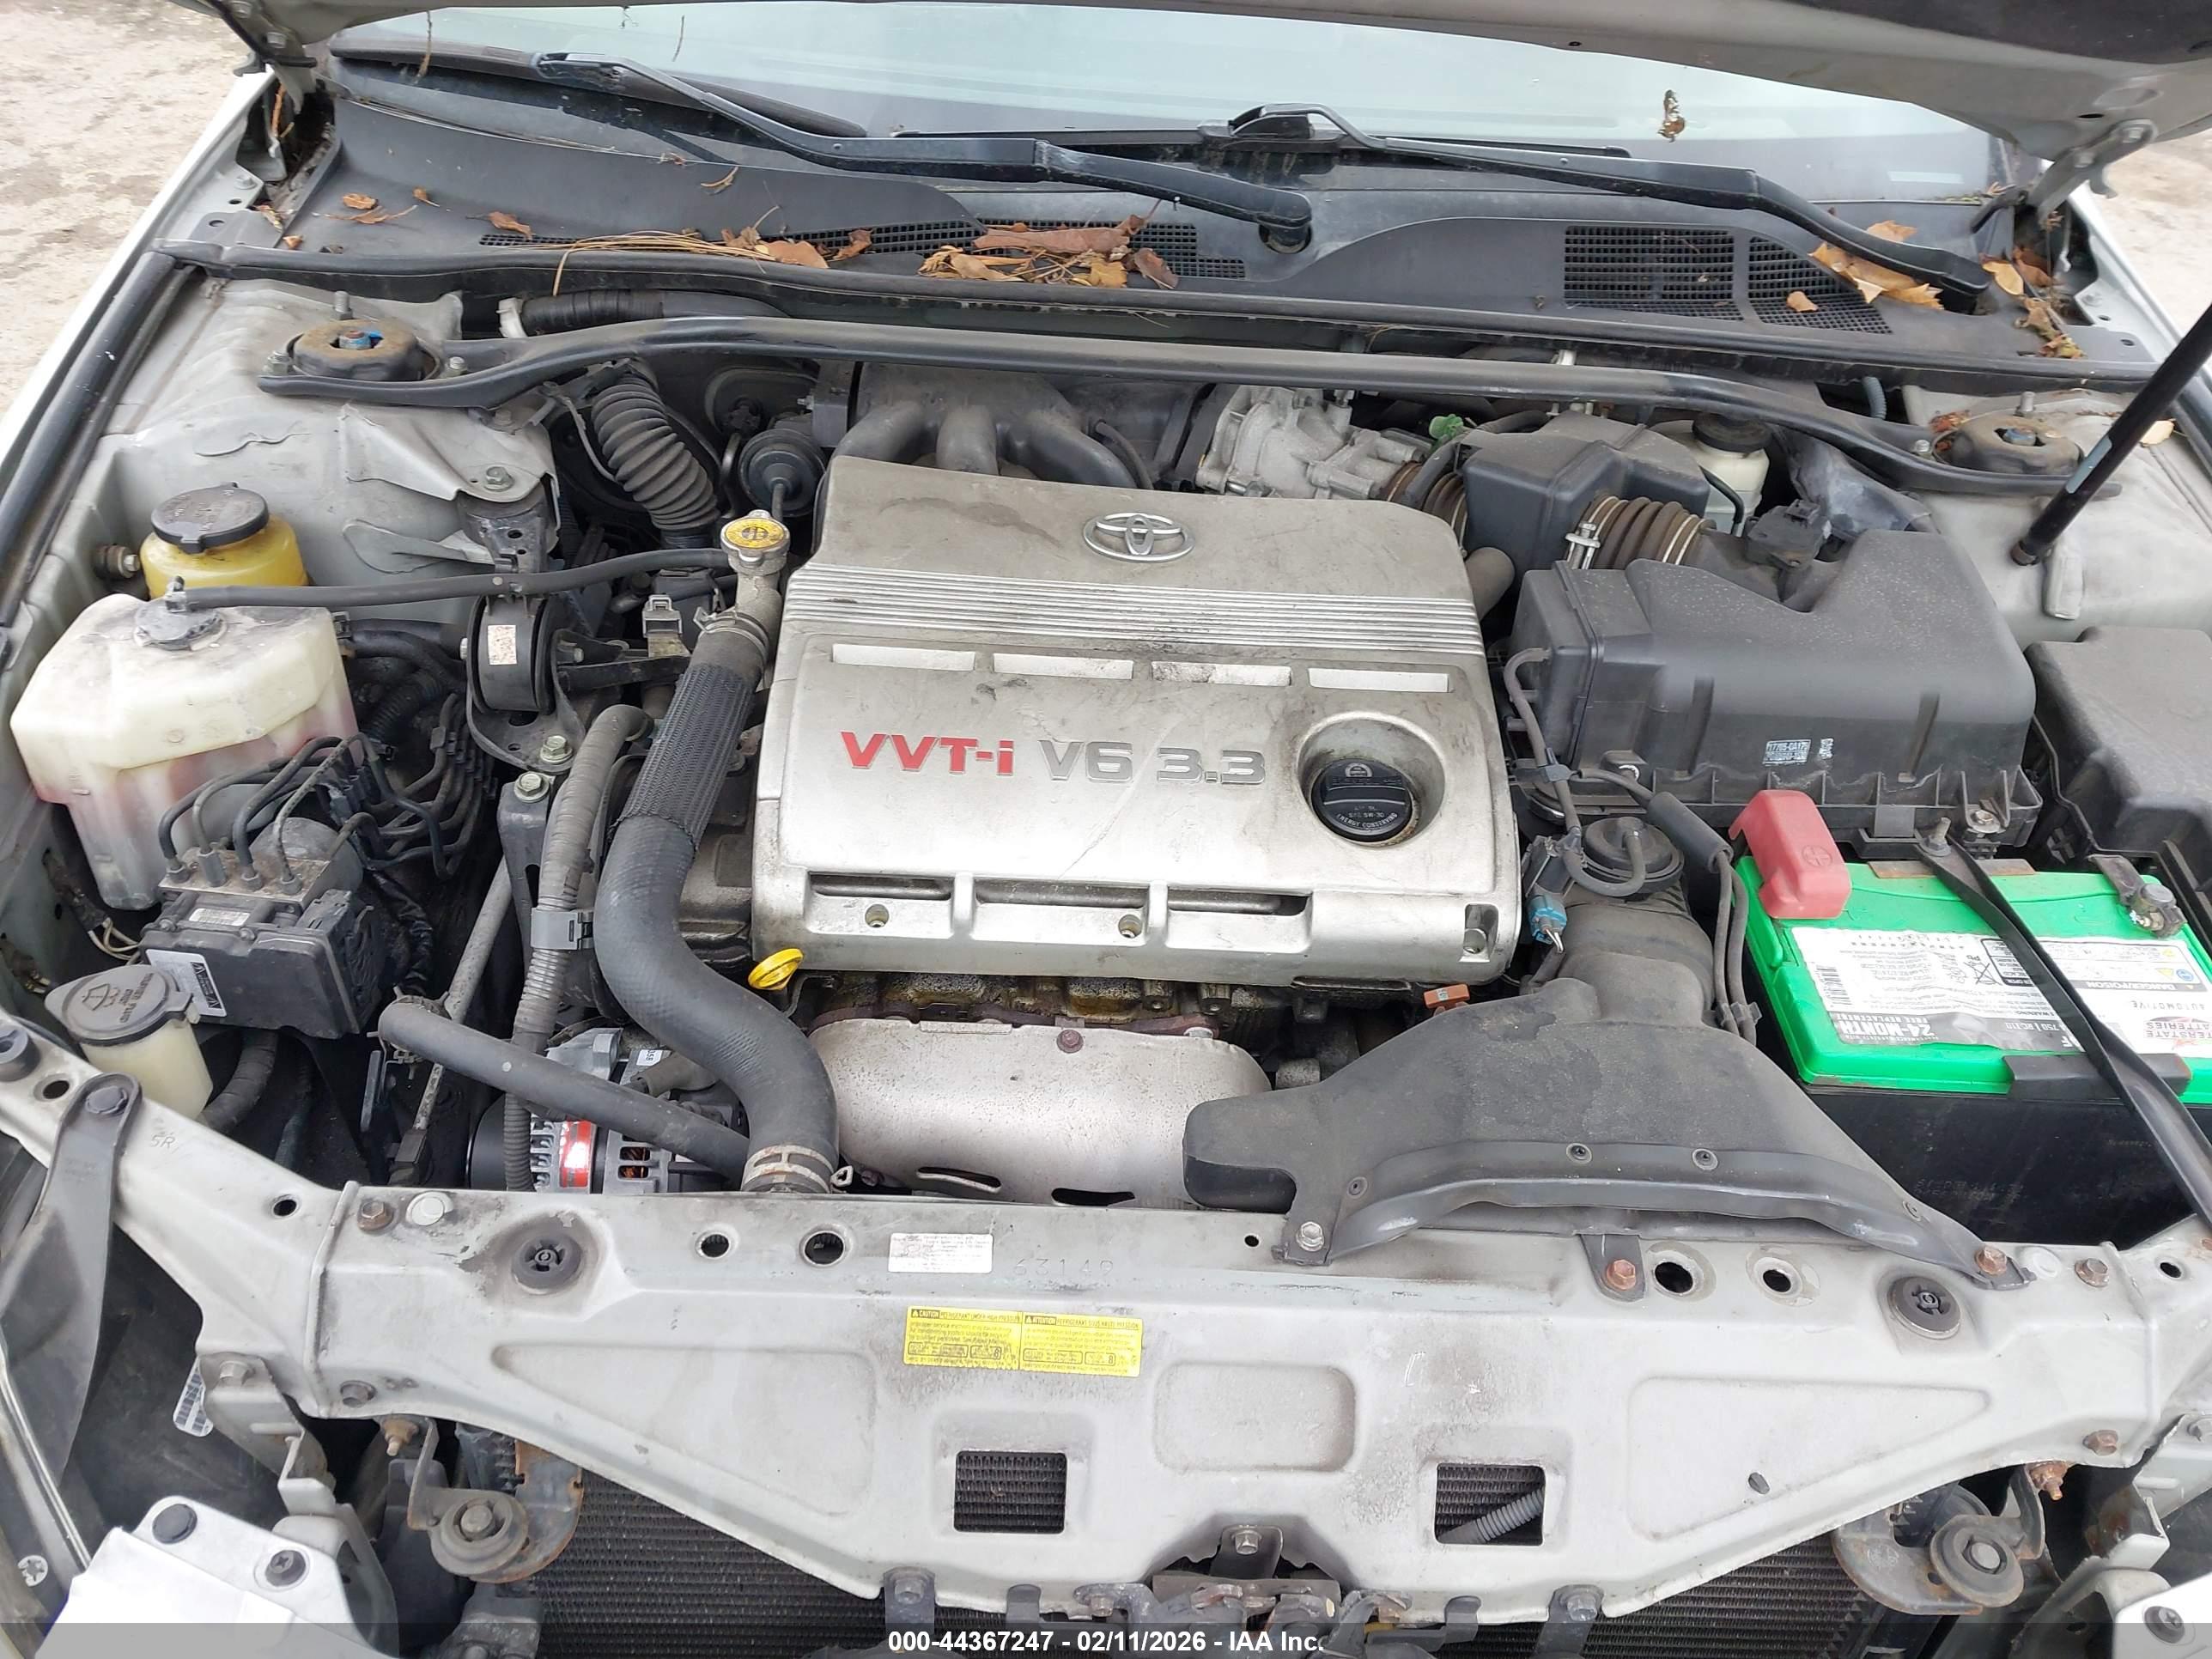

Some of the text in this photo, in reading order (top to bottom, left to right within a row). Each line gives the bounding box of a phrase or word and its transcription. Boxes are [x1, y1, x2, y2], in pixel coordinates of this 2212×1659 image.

[841, 730, 1267, 786] VVT-i V6 3.3
[1836, 1020, 1937, 1037] 24-MONTH
[2146, 1021, 2212, 1030] ATTERIES
